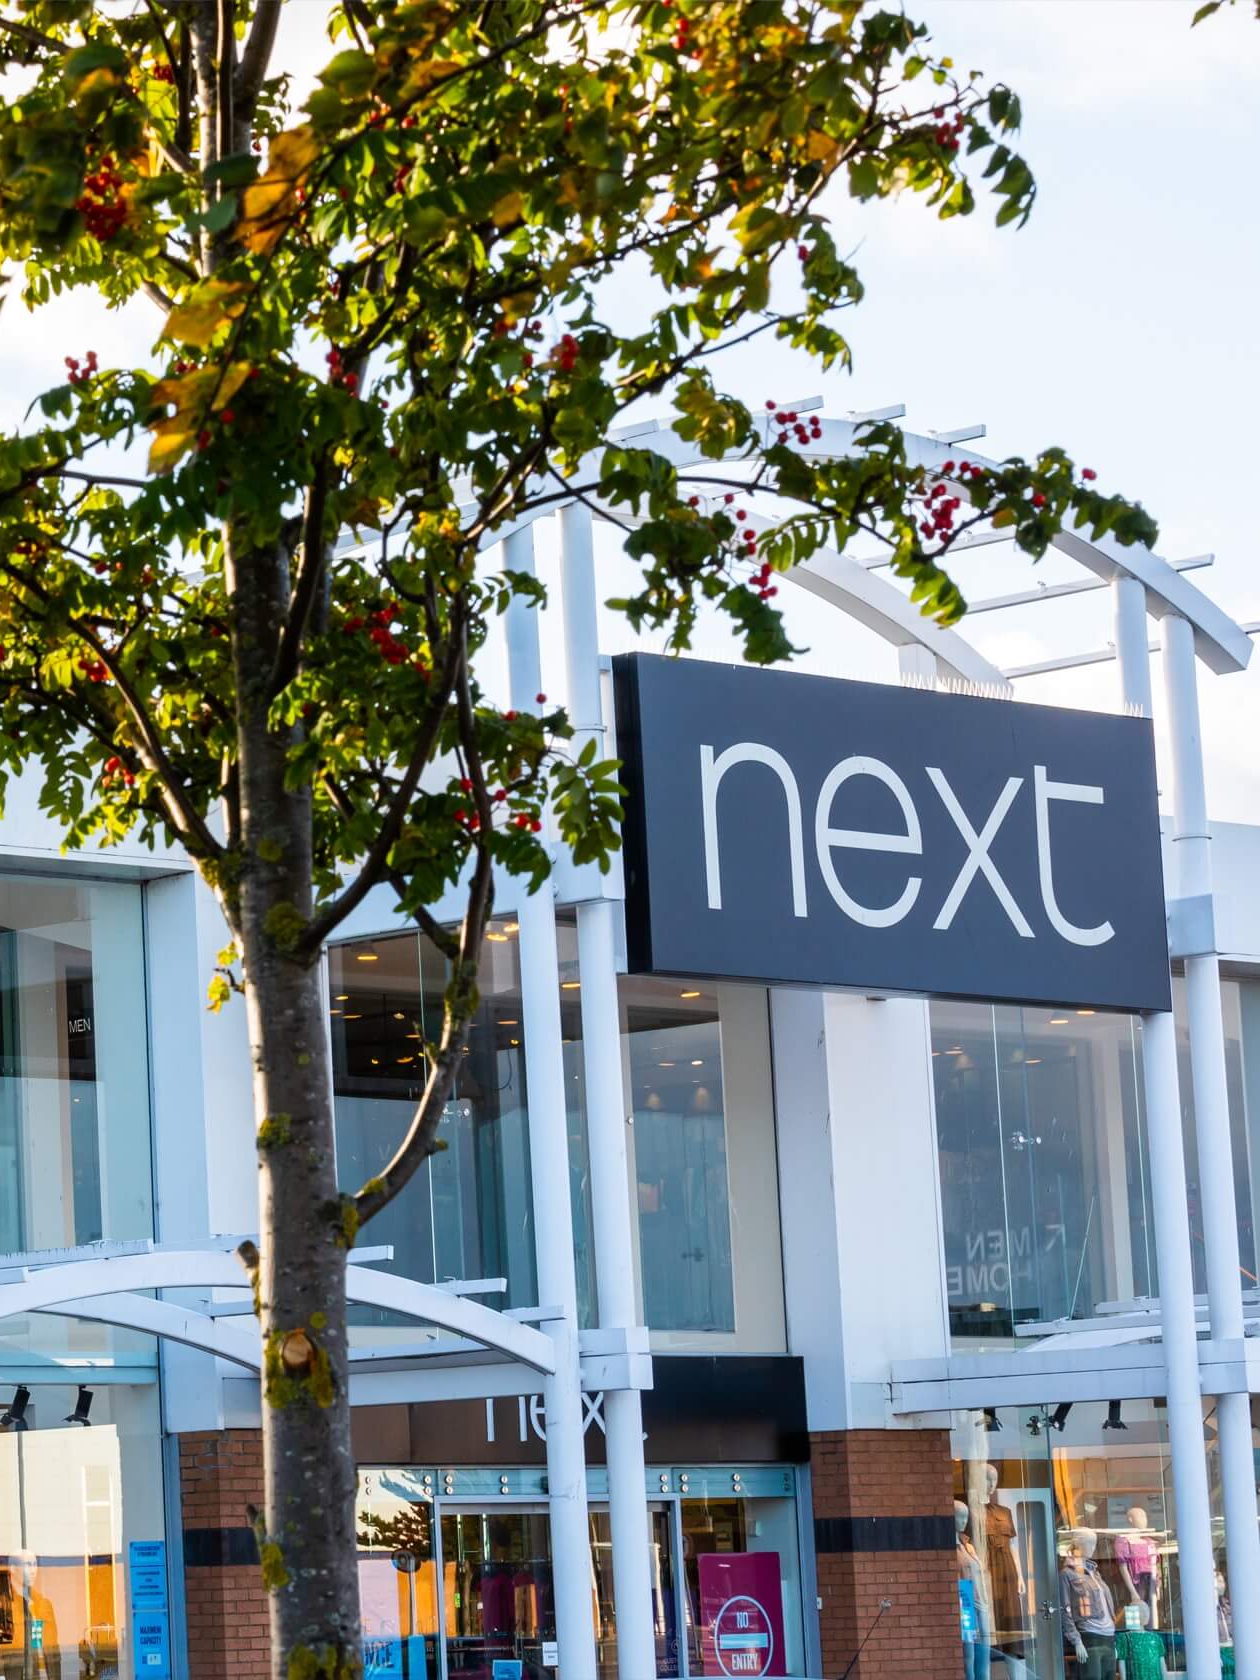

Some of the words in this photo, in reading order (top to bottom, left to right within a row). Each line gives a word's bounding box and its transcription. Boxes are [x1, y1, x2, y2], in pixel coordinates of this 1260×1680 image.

[700, 742, 1116, 946] next
[68, 1017, 91, 1033] MEN
[736, 1611, 749, 1629] NO
[731, 1652, 759, 1671] ENTRY
